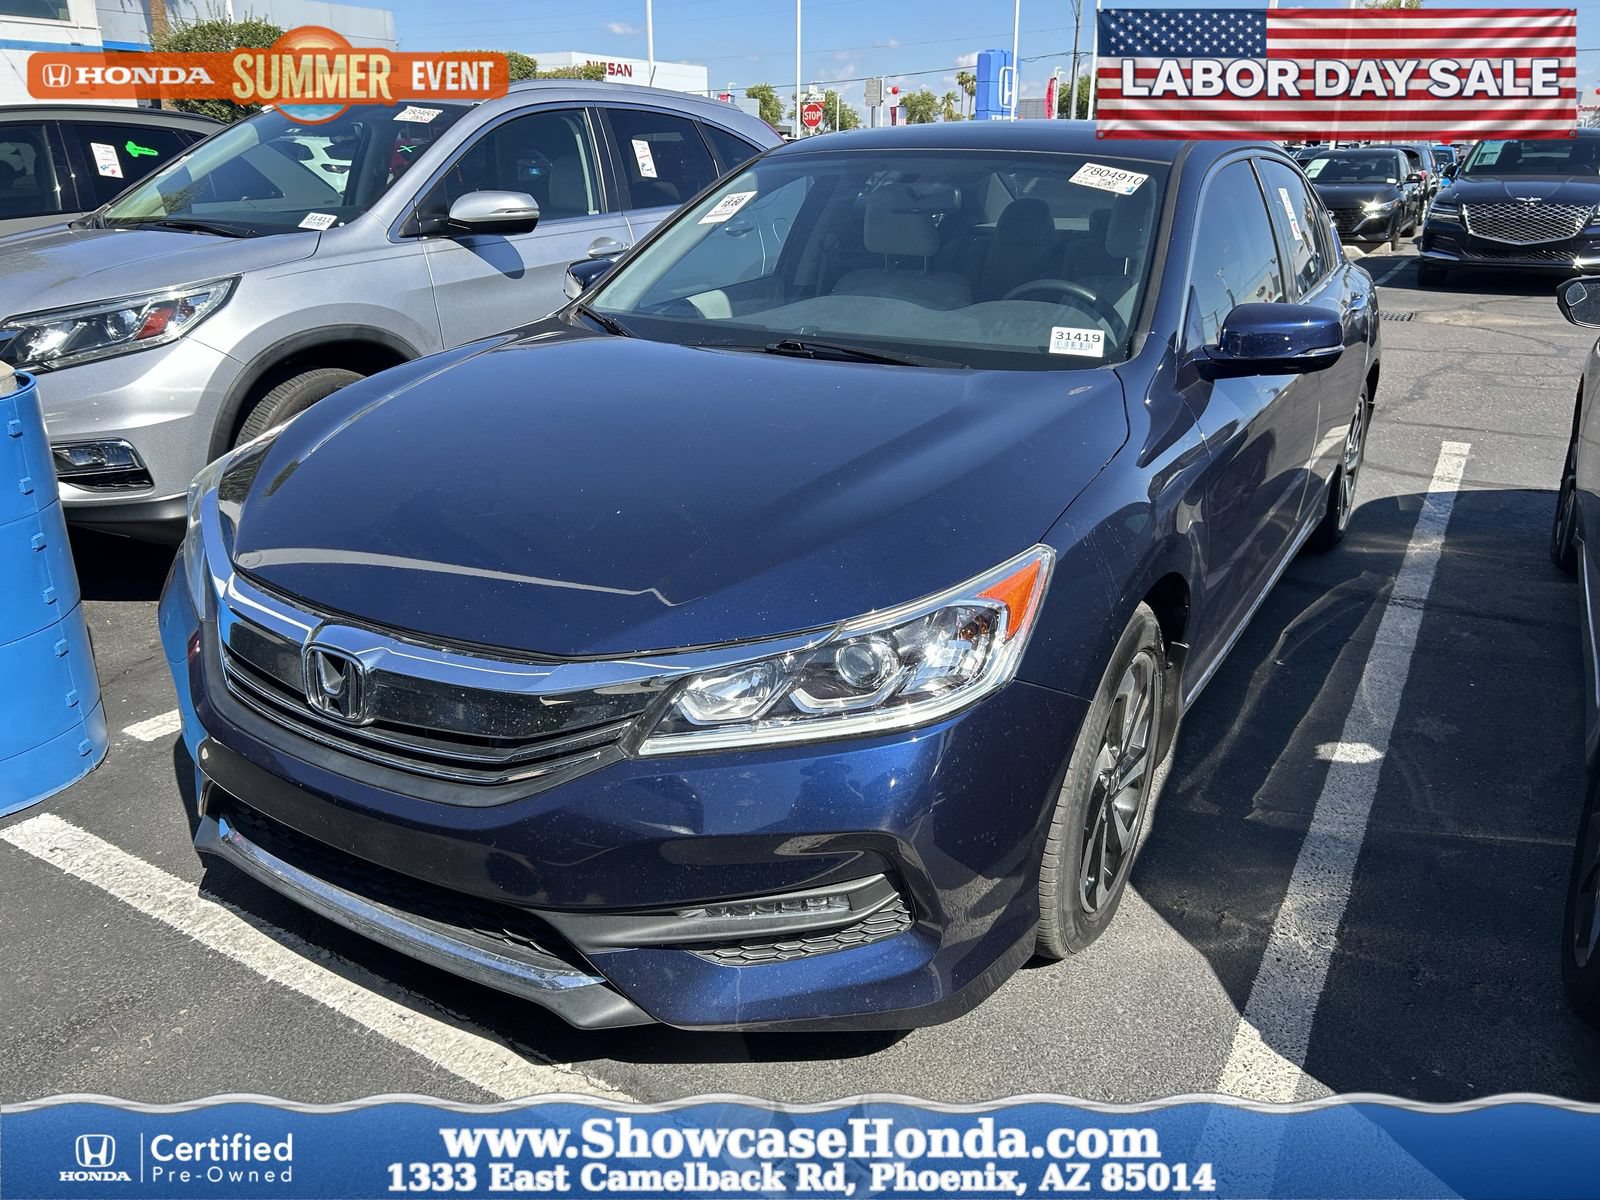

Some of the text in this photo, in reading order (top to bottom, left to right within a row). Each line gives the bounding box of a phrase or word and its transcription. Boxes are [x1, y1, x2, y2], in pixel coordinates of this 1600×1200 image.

[804, 110, 821, 121] STOP
[1083, 165, 1145, 185] 7804910
[1055, 331, 1101, 343] 31419
